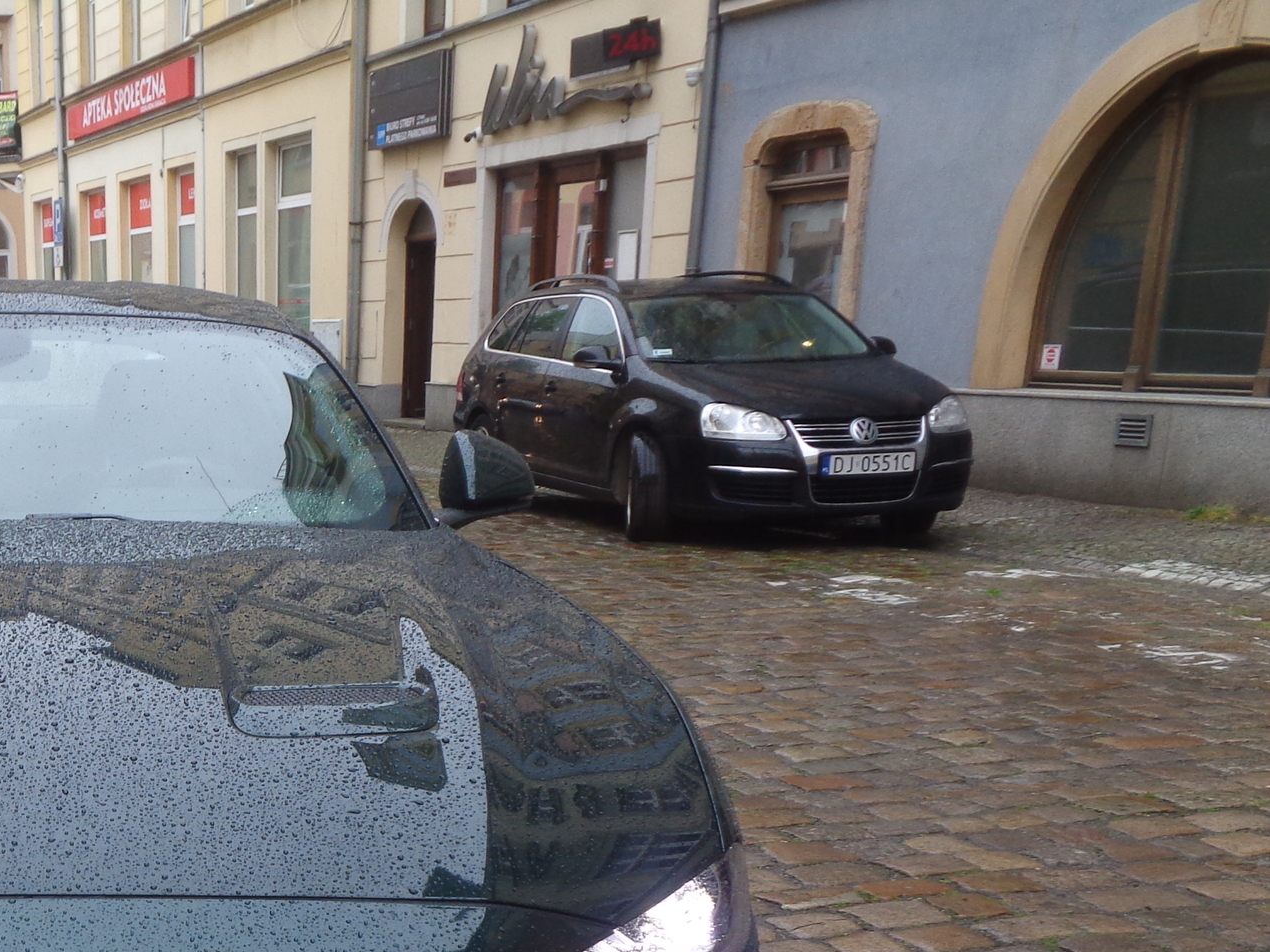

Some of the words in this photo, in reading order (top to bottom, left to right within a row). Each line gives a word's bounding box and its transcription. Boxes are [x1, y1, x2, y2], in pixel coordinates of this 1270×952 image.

[606, 27, 657, 59] 24h
[82, 94, 112, 128] APTEKA
[114, 71, 167, 116] SPOŁECZNA
[833, 456, 854, 474] DJ
[861, 454, 911, 473] 0551C
